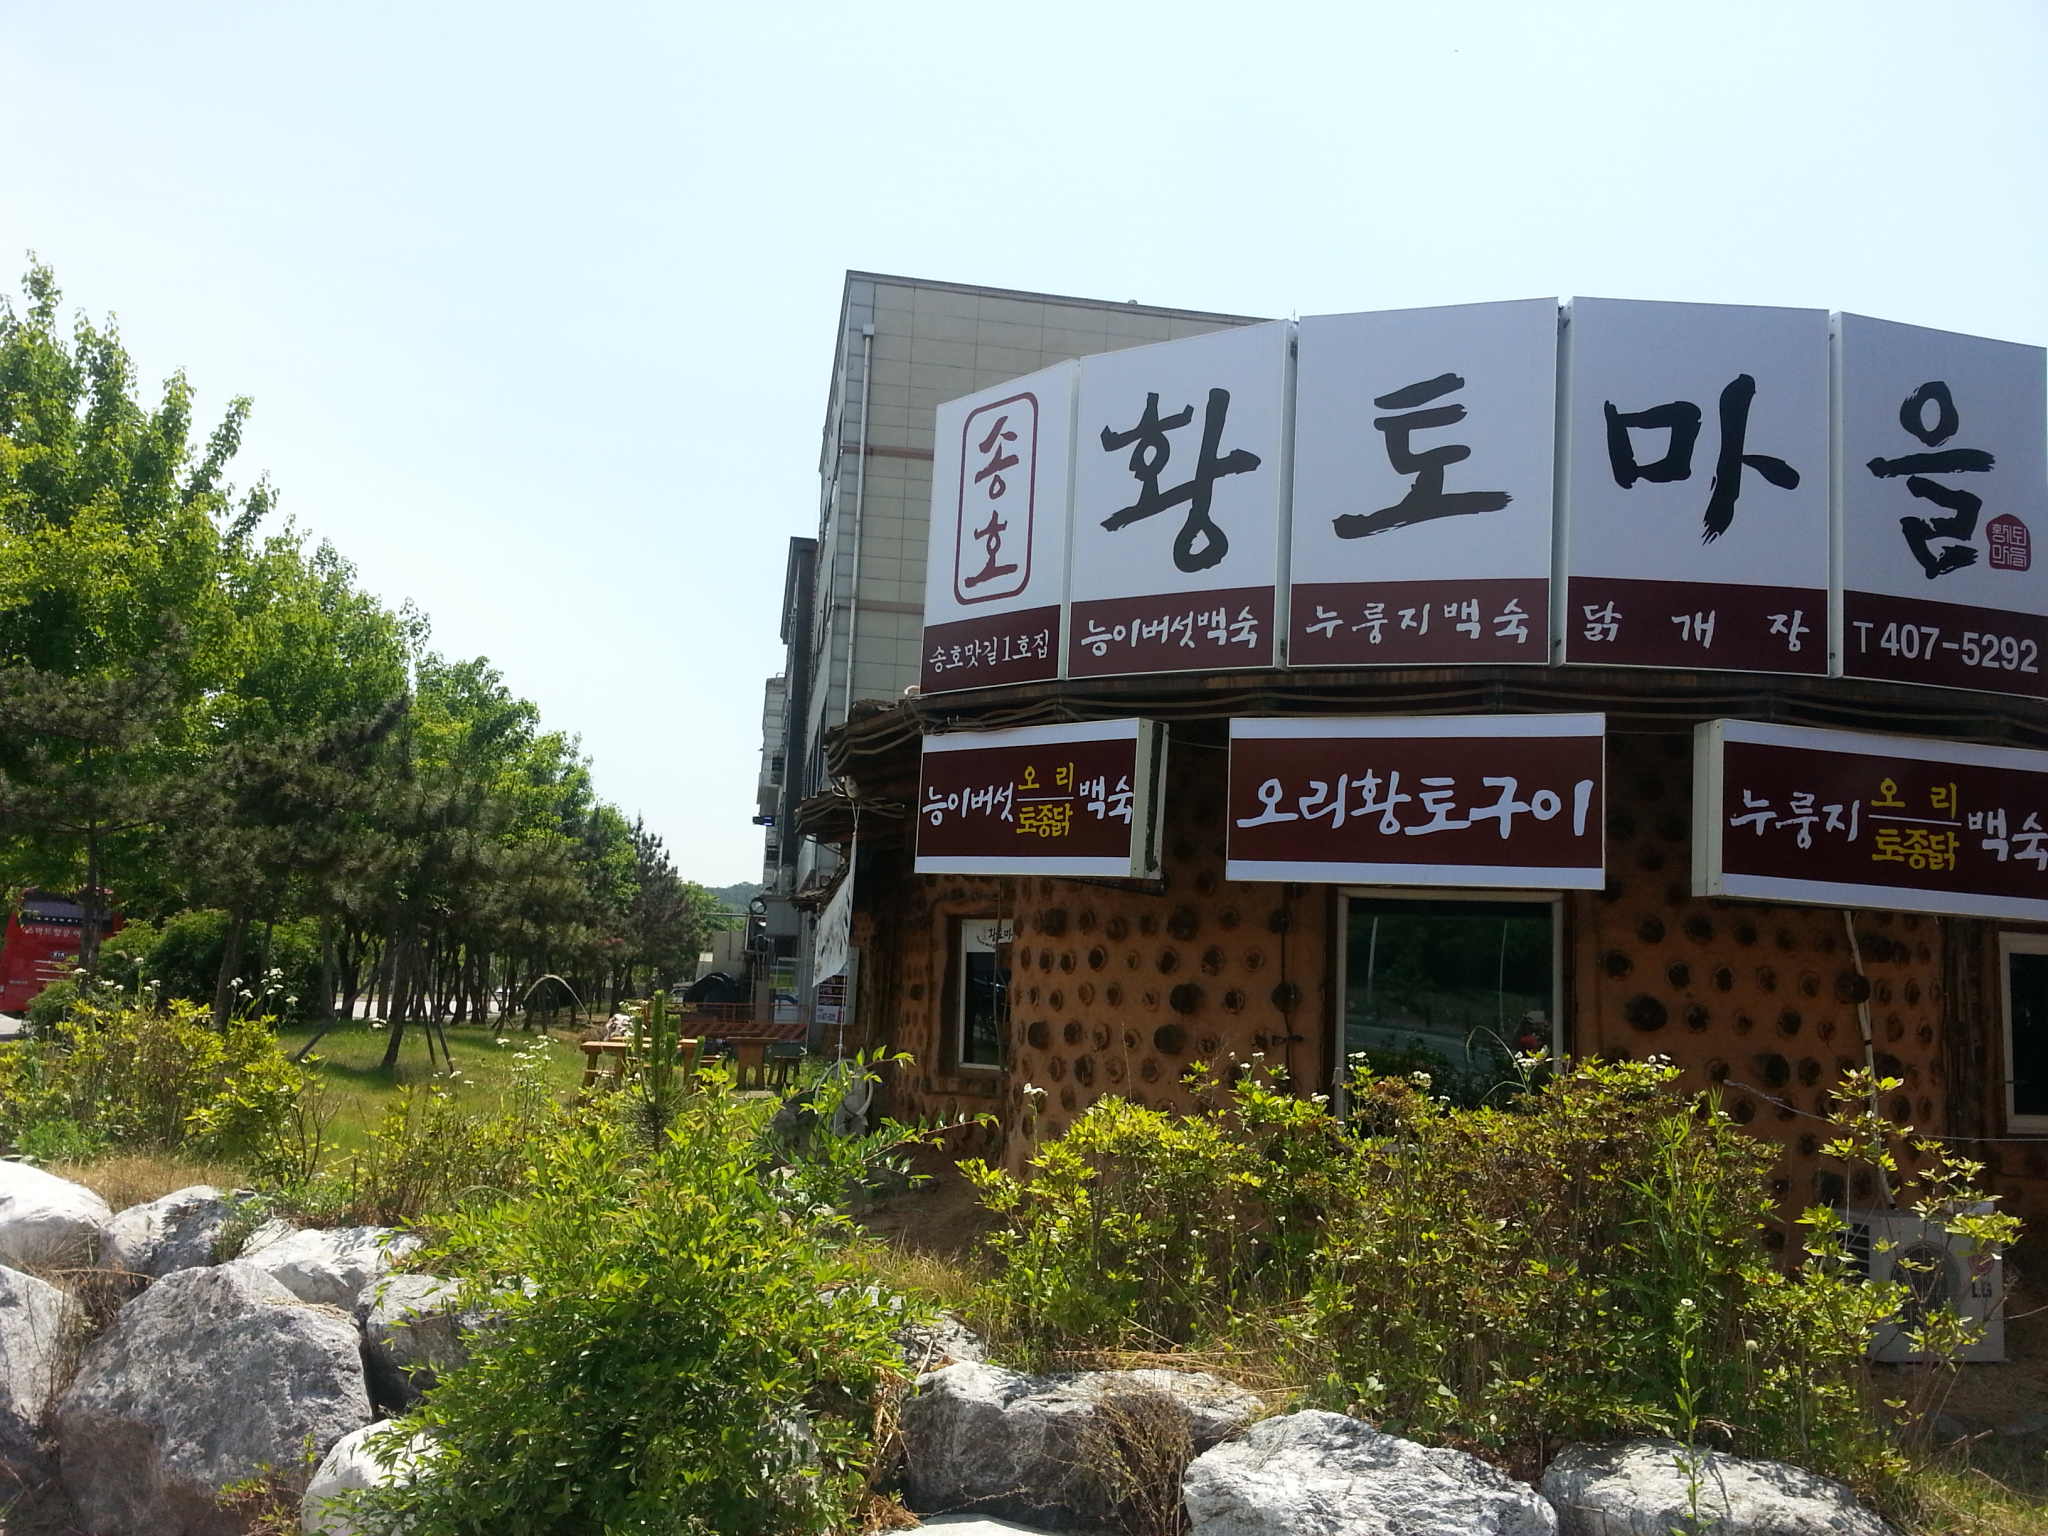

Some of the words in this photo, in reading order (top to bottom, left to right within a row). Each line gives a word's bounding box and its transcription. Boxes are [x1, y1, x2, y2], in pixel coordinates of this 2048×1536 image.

[964, 415, 1020, 588] 송호
[1100, 373, 1996, 580] 황토마을
[1306, 598, 1530, 645] 누룽지백숙
[1582, 600, 1811, 652] 닭개장
[1880, 622, 2040, 675] 407-5292
[922, 781, 1015, 827] 능이버섯
[1079, 774, 1135, 825] 백숙
[1017, 761, 1075, 793] 오리
[1870, 777, 1958, 820] 오리
[1016, 803, 1074, 838] 토종닭
[1235, 768, 1595, 840] 오리황토구이
[1729, 788, 1861, 850] 누룽지
[1968, 807, 2048, 871] 백숙
[1871, 828, 1961, 872] 토종닭
[1971, 1282, 1994, 1299] LG
